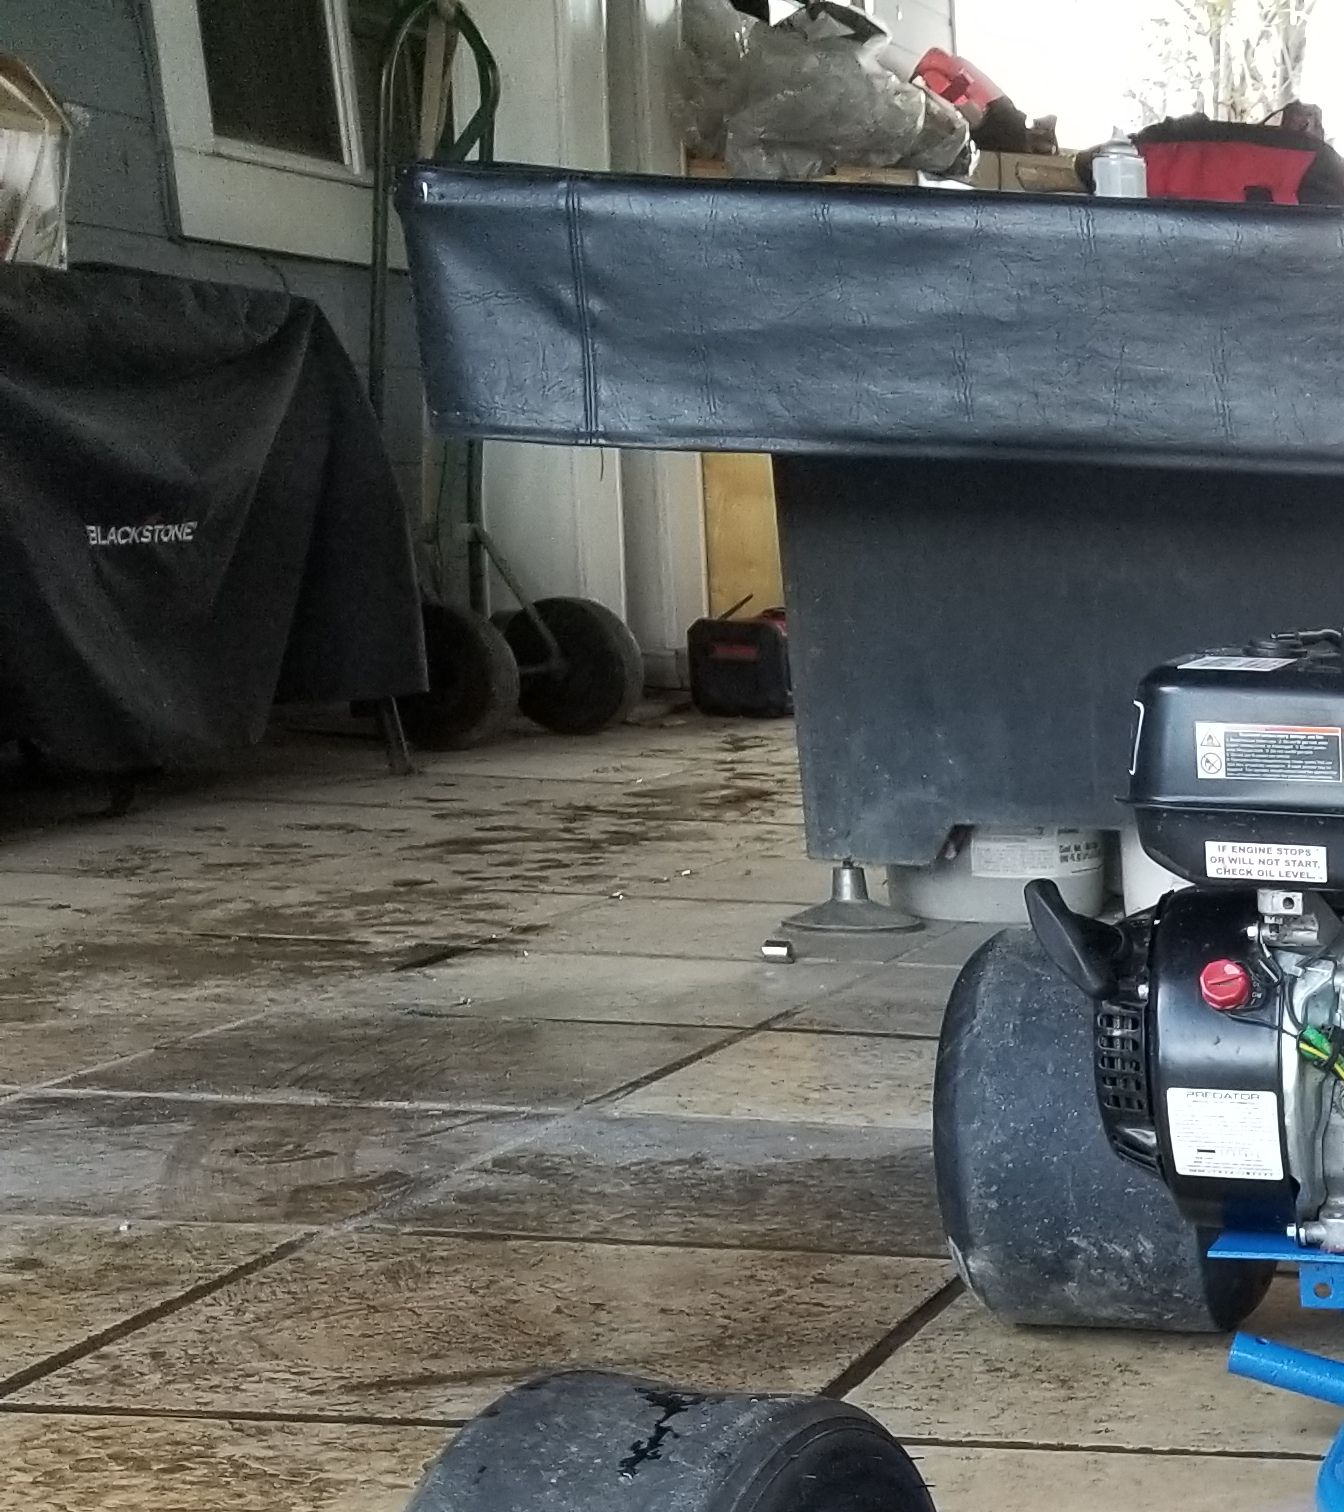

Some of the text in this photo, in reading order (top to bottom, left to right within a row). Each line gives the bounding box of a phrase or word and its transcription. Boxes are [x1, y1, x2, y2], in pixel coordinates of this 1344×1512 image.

[86, 521, 198, 546] BLACKSTONE
[1217, 844, 1312, 857] IF ENGINE STOPS
[1209, 855, 1225, 865] OR
[1228, 856, 1254, 866] WILL
[1258, 858, 1280, 867] NOT
[1216, 867, 1253, 877] CHECK
[1257, 869, 1275, 878] OIL
[1186, 1091, 1260, 1101] PREDATOR
